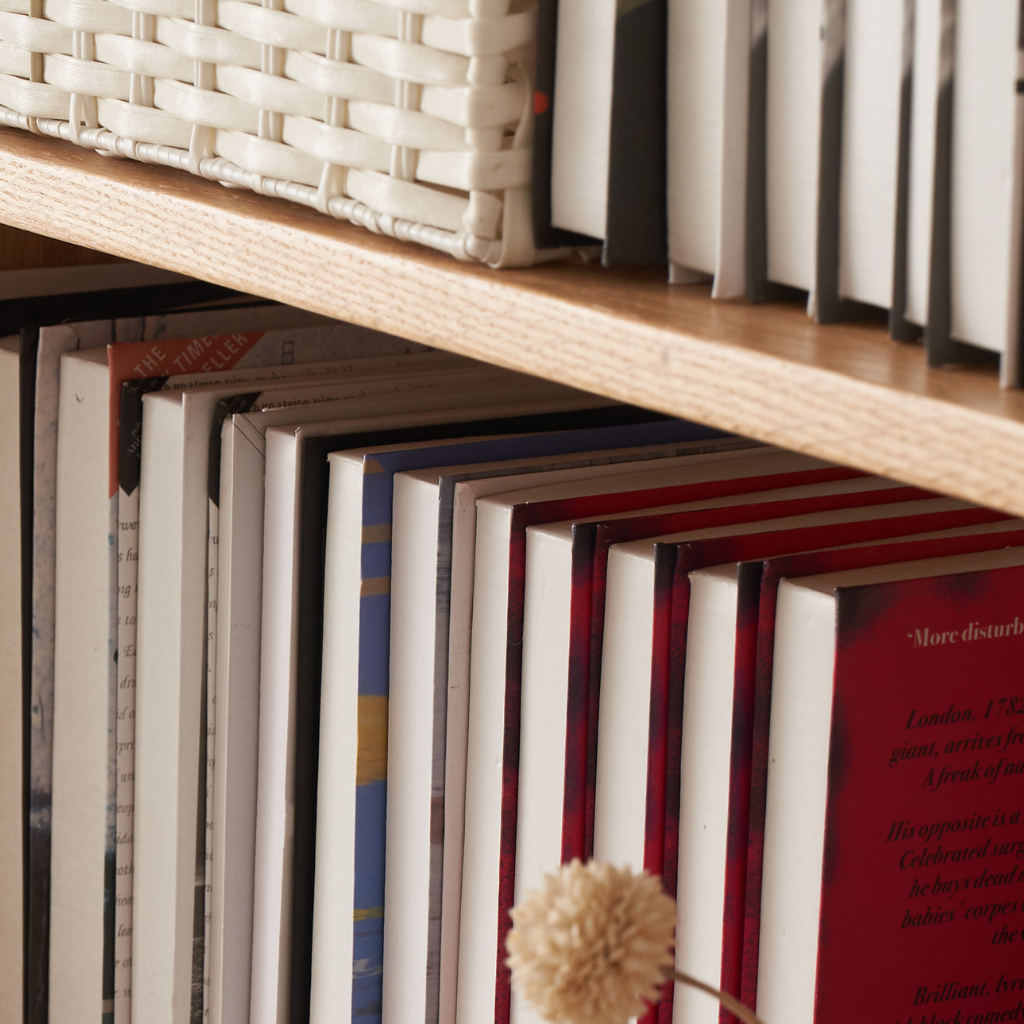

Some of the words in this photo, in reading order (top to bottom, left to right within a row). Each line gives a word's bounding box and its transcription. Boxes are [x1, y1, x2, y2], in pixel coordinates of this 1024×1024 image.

[133, 345, 166, 378] THE
[173, 334, 218, 372] TIME
[907, 627, 959, 649] ‘More
[961, 616, 1024, 643] disturb
[905, 704, 976, 730] London,
[888, 741, 939, 769] giant,
[944, 731, 1004, 755] arrives
[920, 767, 935, 789] A
[931, 761, 984, 793] freak
[984, 757, 1007, 784] of
[885, 820, 917, 843] His
[918, 811, 991, 843] opposite
[991, 807, 1007, 828] is
[1009, 810, 1021, 825] a
[899, 837, 991, 871] Celebrated
[908, 877, 930, 899] he
[931, 875, 971, 899] buys
[973, 864, 1018, 889] dead
[991, 924, 1018, 946] the
[912, 981, 990, 1007] Brilliant,
